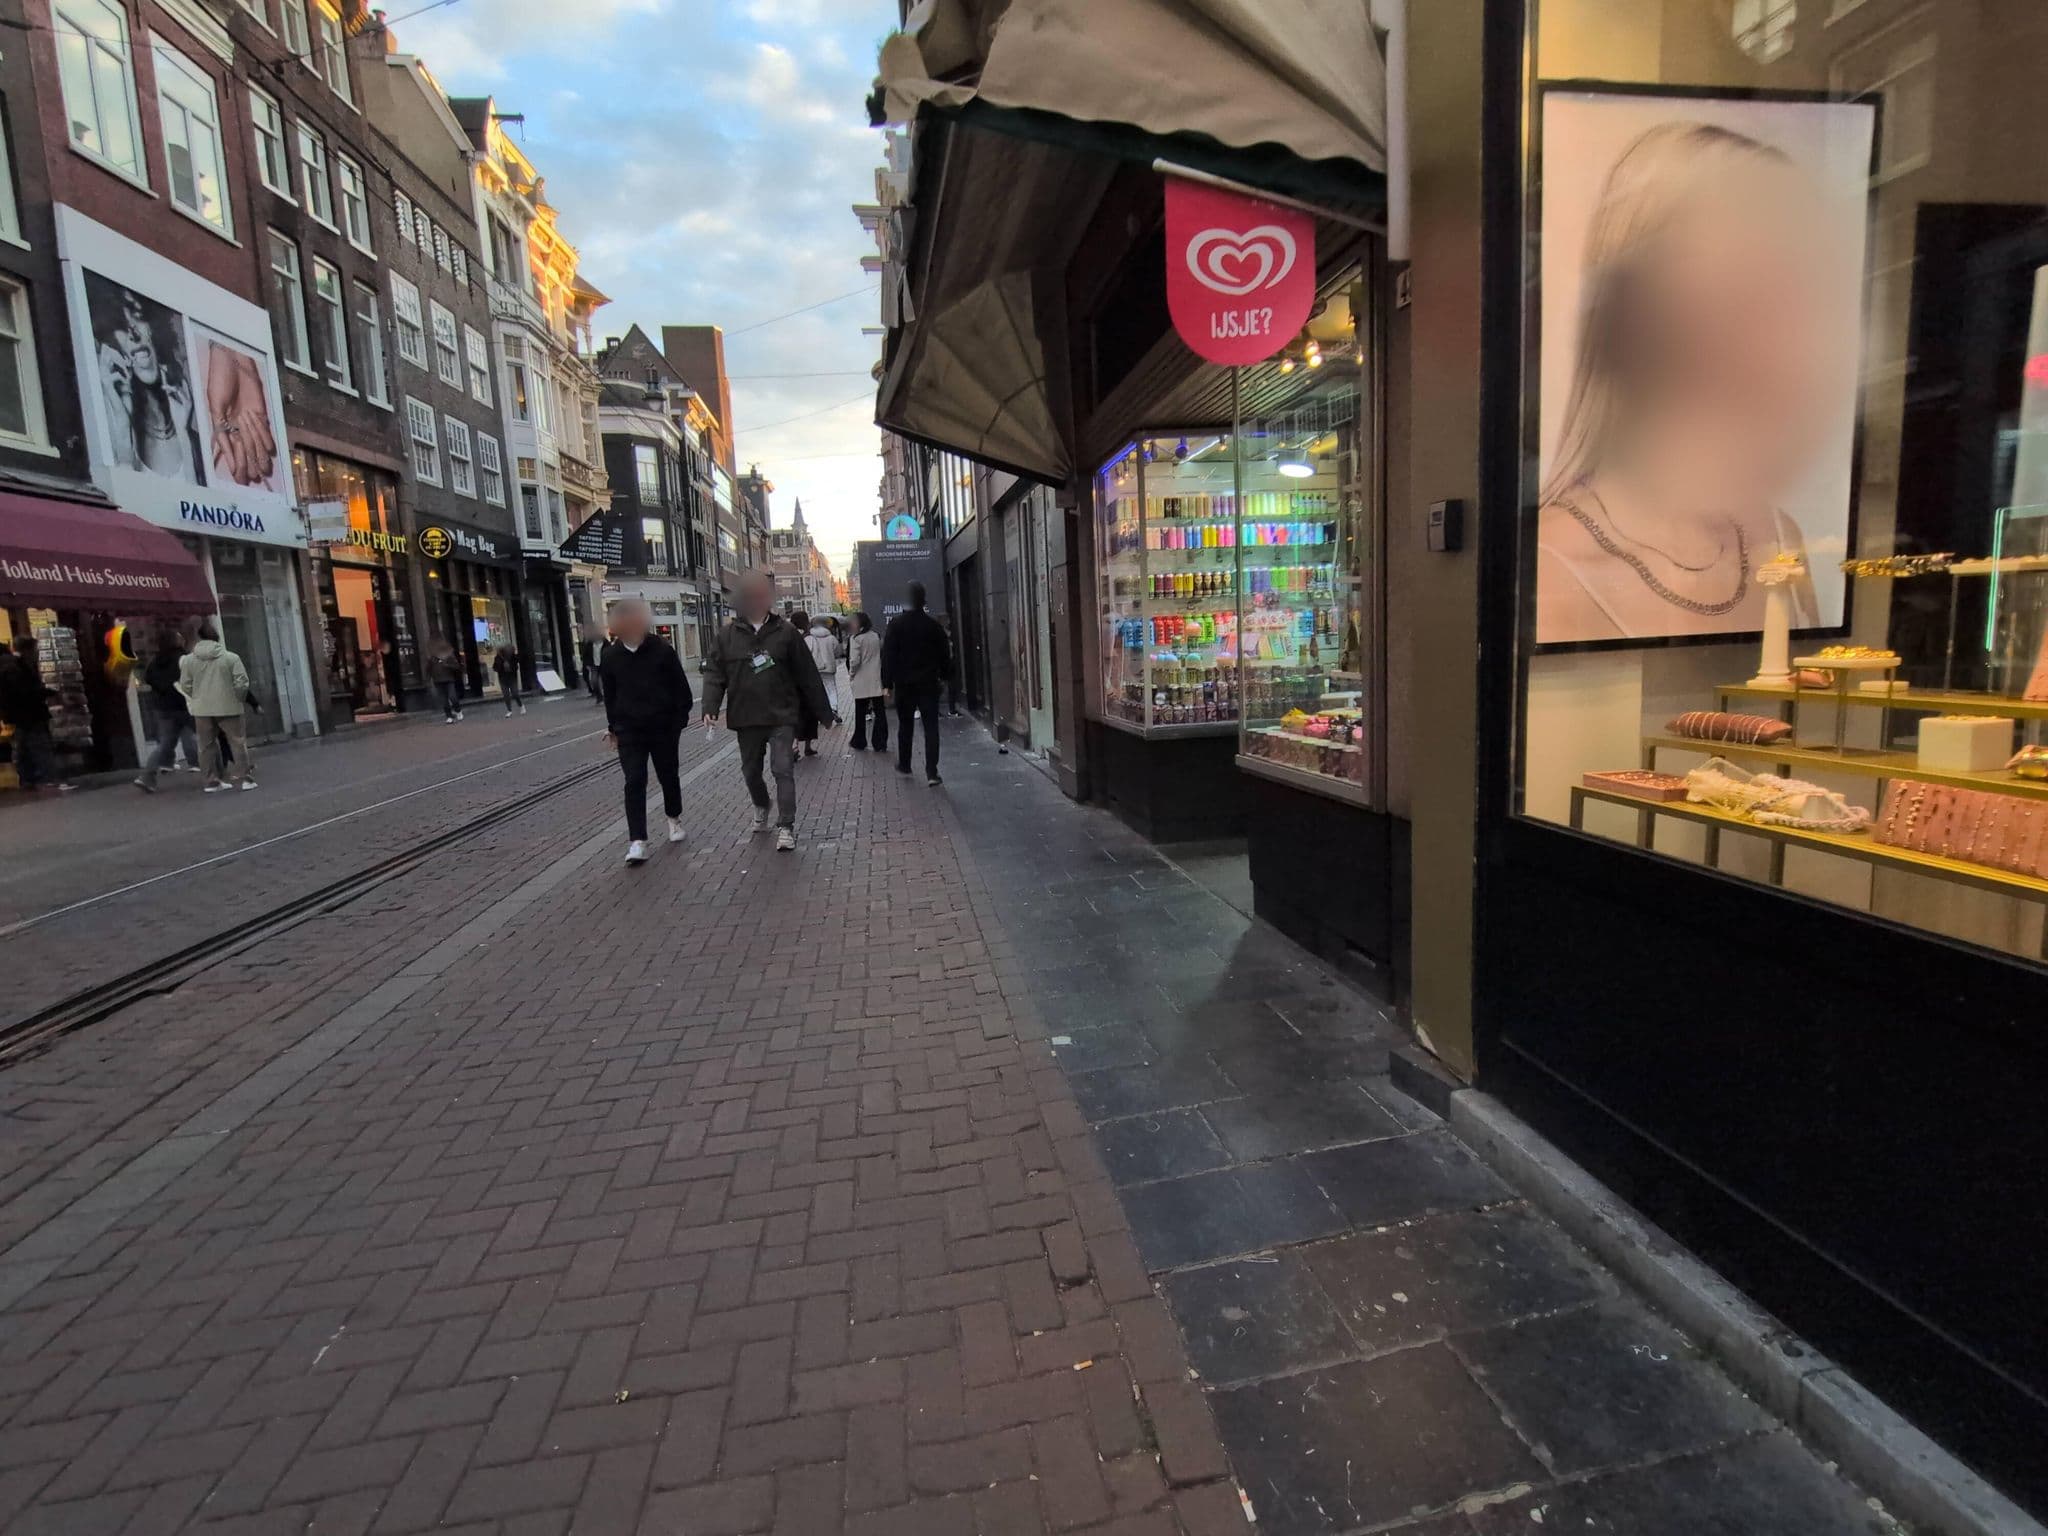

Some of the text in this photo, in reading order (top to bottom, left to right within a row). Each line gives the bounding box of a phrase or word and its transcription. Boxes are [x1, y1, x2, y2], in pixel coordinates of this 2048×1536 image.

[1211, 307, 1272, 339] IJSJE?
[180, 501, 265, 533] PANDORA
[352, 528, 370, 547] DU
[64, 565, 104, 585] Huis
[104, 569, 170, 589] Souvenirs
